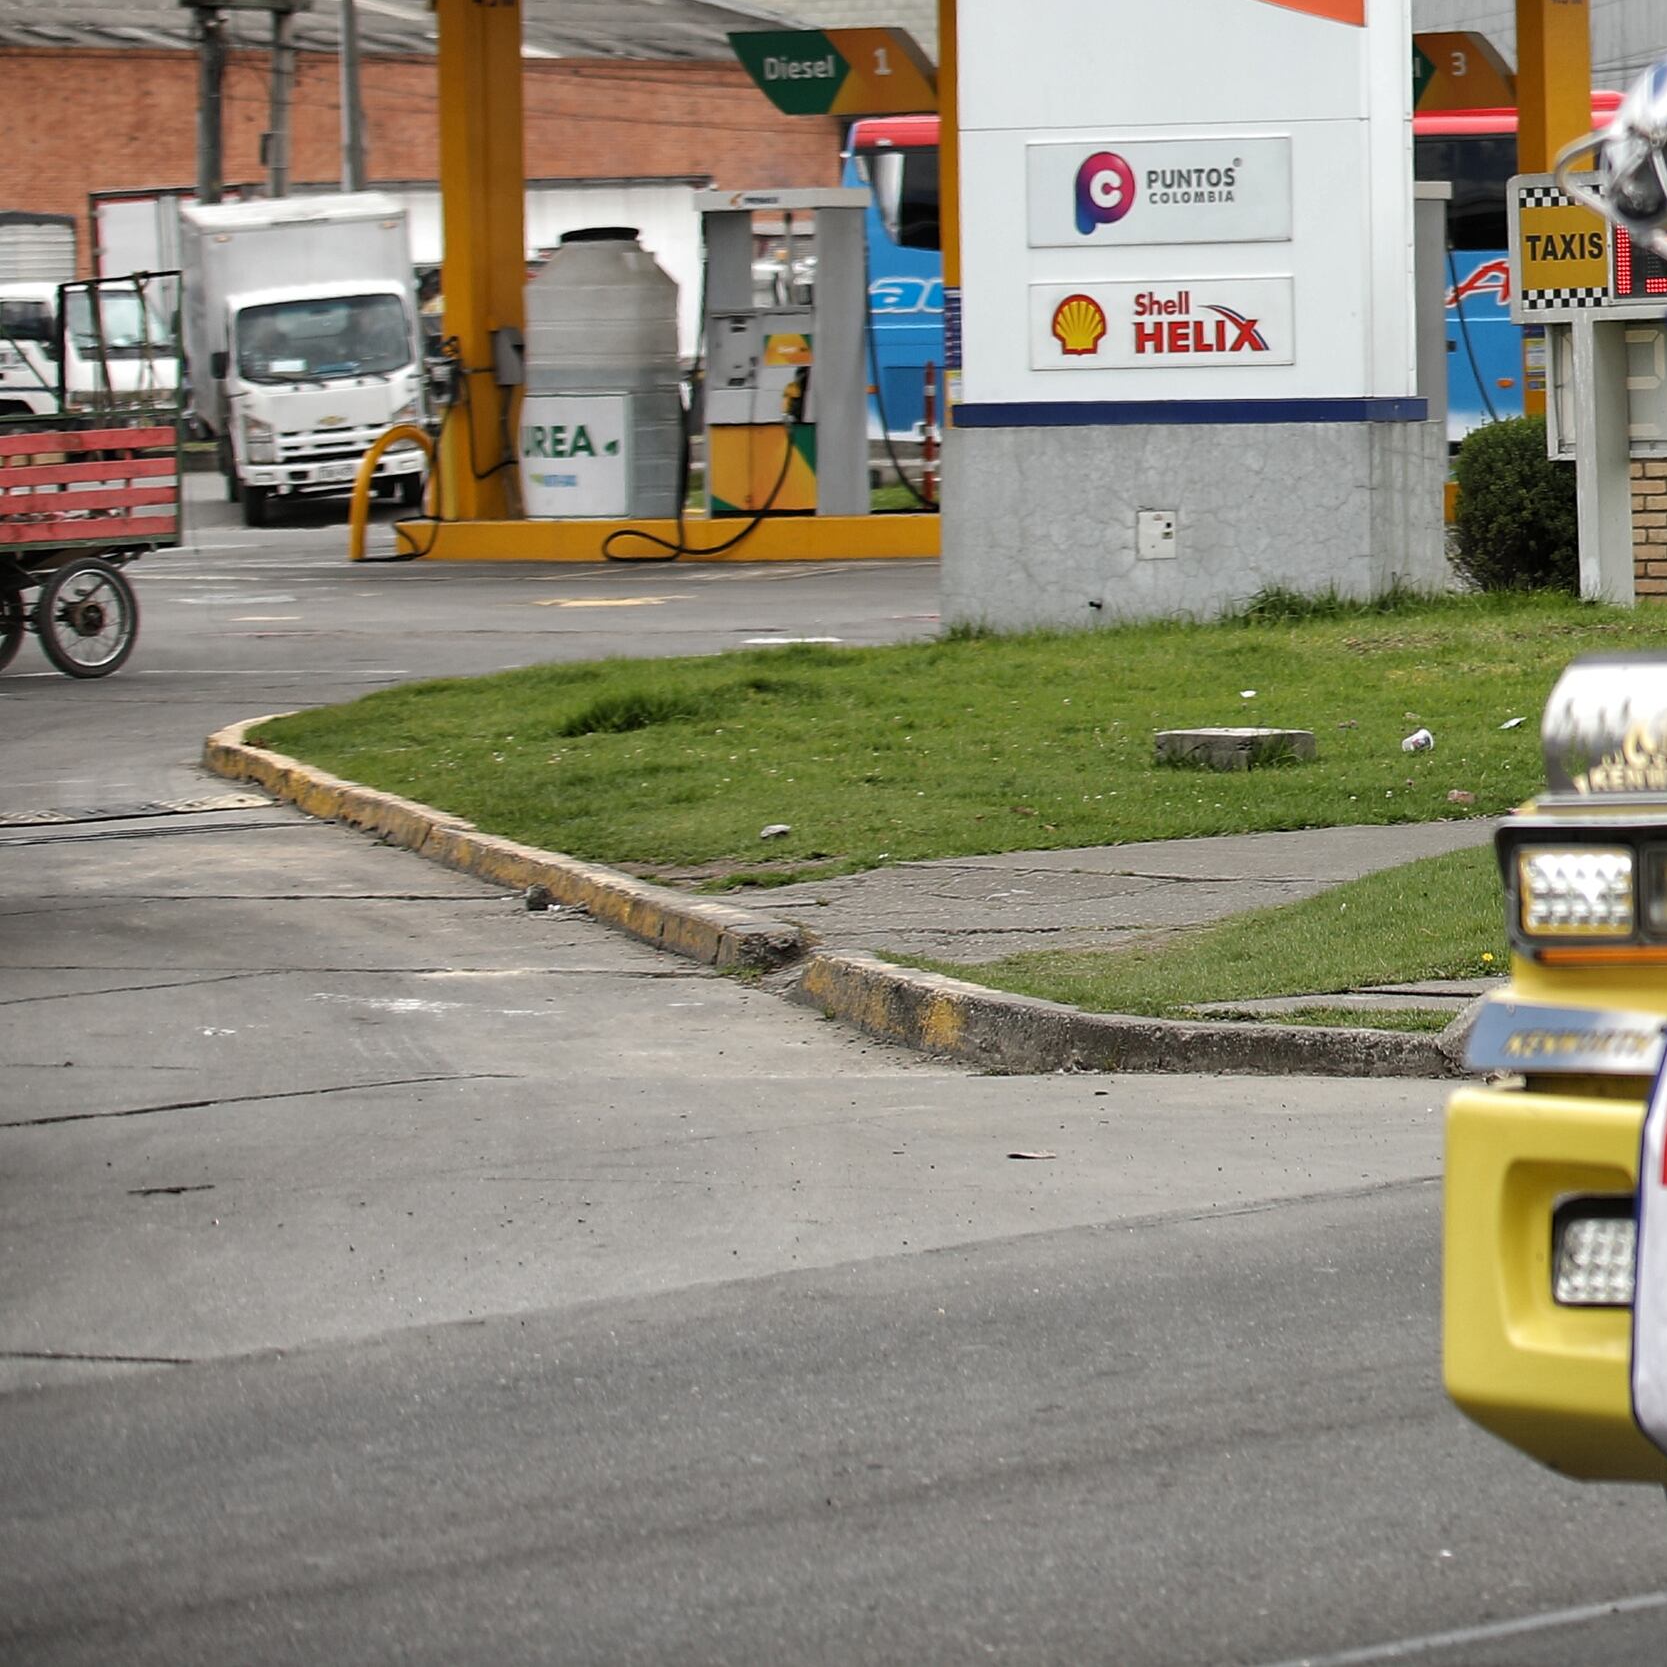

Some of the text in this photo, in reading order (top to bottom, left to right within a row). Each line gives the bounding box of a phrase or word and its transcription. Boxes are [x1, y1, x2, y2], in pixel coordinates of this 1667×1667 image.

[763, 48, 892, 81] Diesel 1
[1450, 51, 1467, 77] 3
[1146, 167, 1236, 189] PUNTOS
[1148, 191, 1236, 205] COLOMBIA
[1526, 232, 1604, 262] TAXIS
[1134, 290, 1190, 316] Shell
[1134, 317, 1266, 355] HELIX
